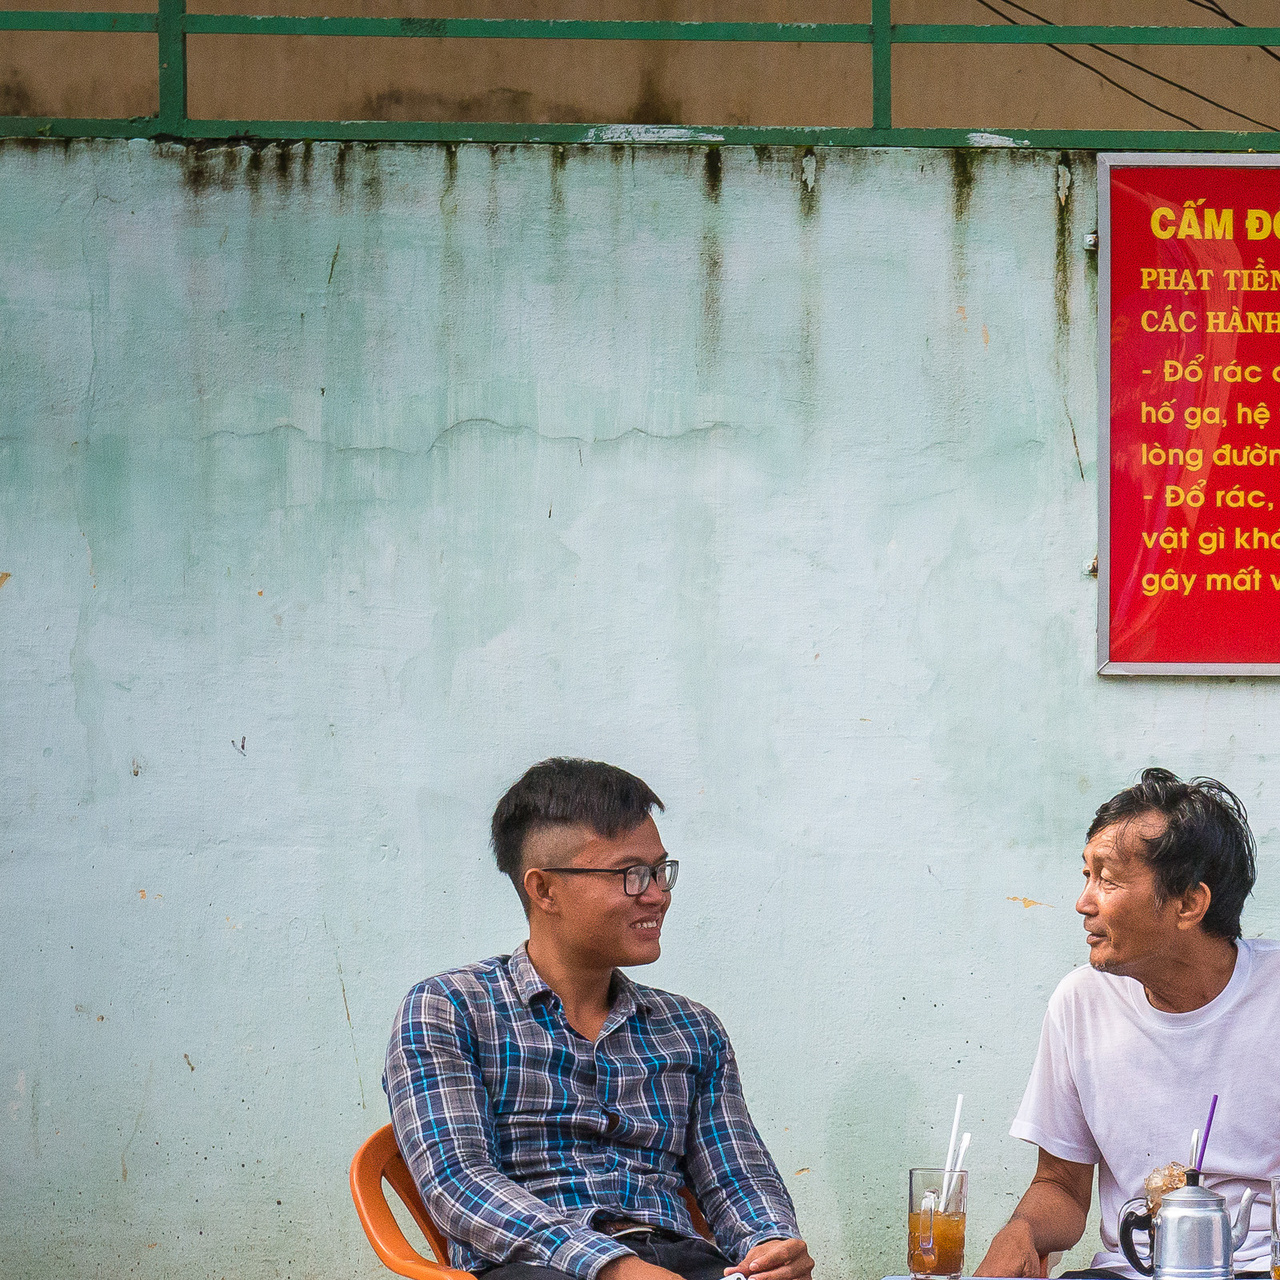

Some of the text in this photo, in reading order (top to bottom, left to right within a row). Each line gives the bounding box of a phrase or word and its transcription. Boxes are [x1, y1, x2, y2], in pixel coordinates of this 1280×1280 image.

[1150, 198, 1234, 240] CẤM
[1140, 267, 1214, 296] PHẠT
[1140, 304, 1196, 333] CÁC
[1163, 353, 1205, 383] Đổ
[1213, 359, 1262, 383] rác
[1141, 398, 1176, 424] hố
[1184, 406, 1227, 430] ga,
[1237, 402, 1271, 430] hệ
[1141, 442, 1204, 472] lòng
[1164, 478, 1207, 508] Đổ
[1216, 484, 1274, 511] rác,
[1141, 526, 1190, 554] vật
[1198, 526, 1225, 556] gì
[1141, 568, 1197, 597] gây
[1206, 565, 1263, 592] mất
